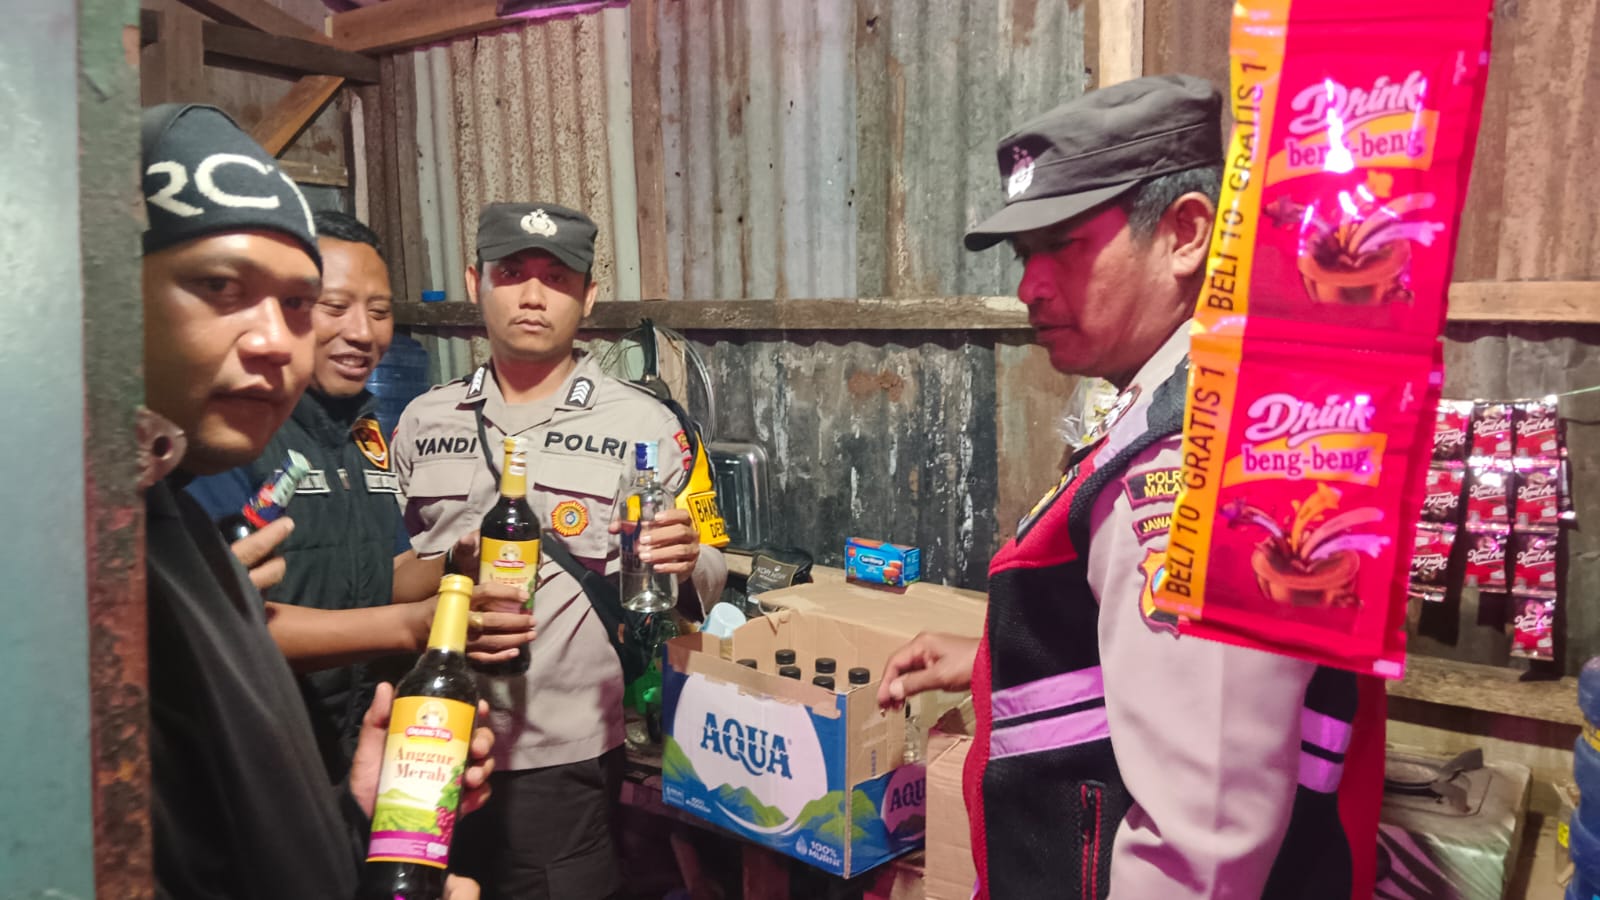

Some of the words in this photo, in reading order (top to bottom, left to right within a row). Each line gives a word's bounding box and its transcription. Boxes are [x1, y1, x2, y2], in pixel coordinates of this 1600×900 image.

[1241, 62, 1268, 74] 1
[1288, 70, 1427, 135] Drink
[1229, 83, 1264, 193] GRATIS
[1220, 208, 1244, 241] 10
[1208, 252, 1239, 311] BELI
[1200, 365, 1225, 378] 1
[1244, 393, 1375, 447] Drink
[415, 437, 478, 456] YANDI
[544, 431, 628, 459] POLRI
[1183, 388, 1222, 489] GRATIS
[1243, 445, 1373, 477] beng-beng
[1144, 483, 1183, 498] MALA
[1146, 470, 1183, 486] POLR
[1176, 504, 1201, 534] 10
[1165, 545, 1196, 598] BELI
[394, 746, 455, 767] Anggur
[700, 712, 793, 780] AQUA
[395, 763, 447, 783] Merah
[889, 778, 926, 813] AQU
